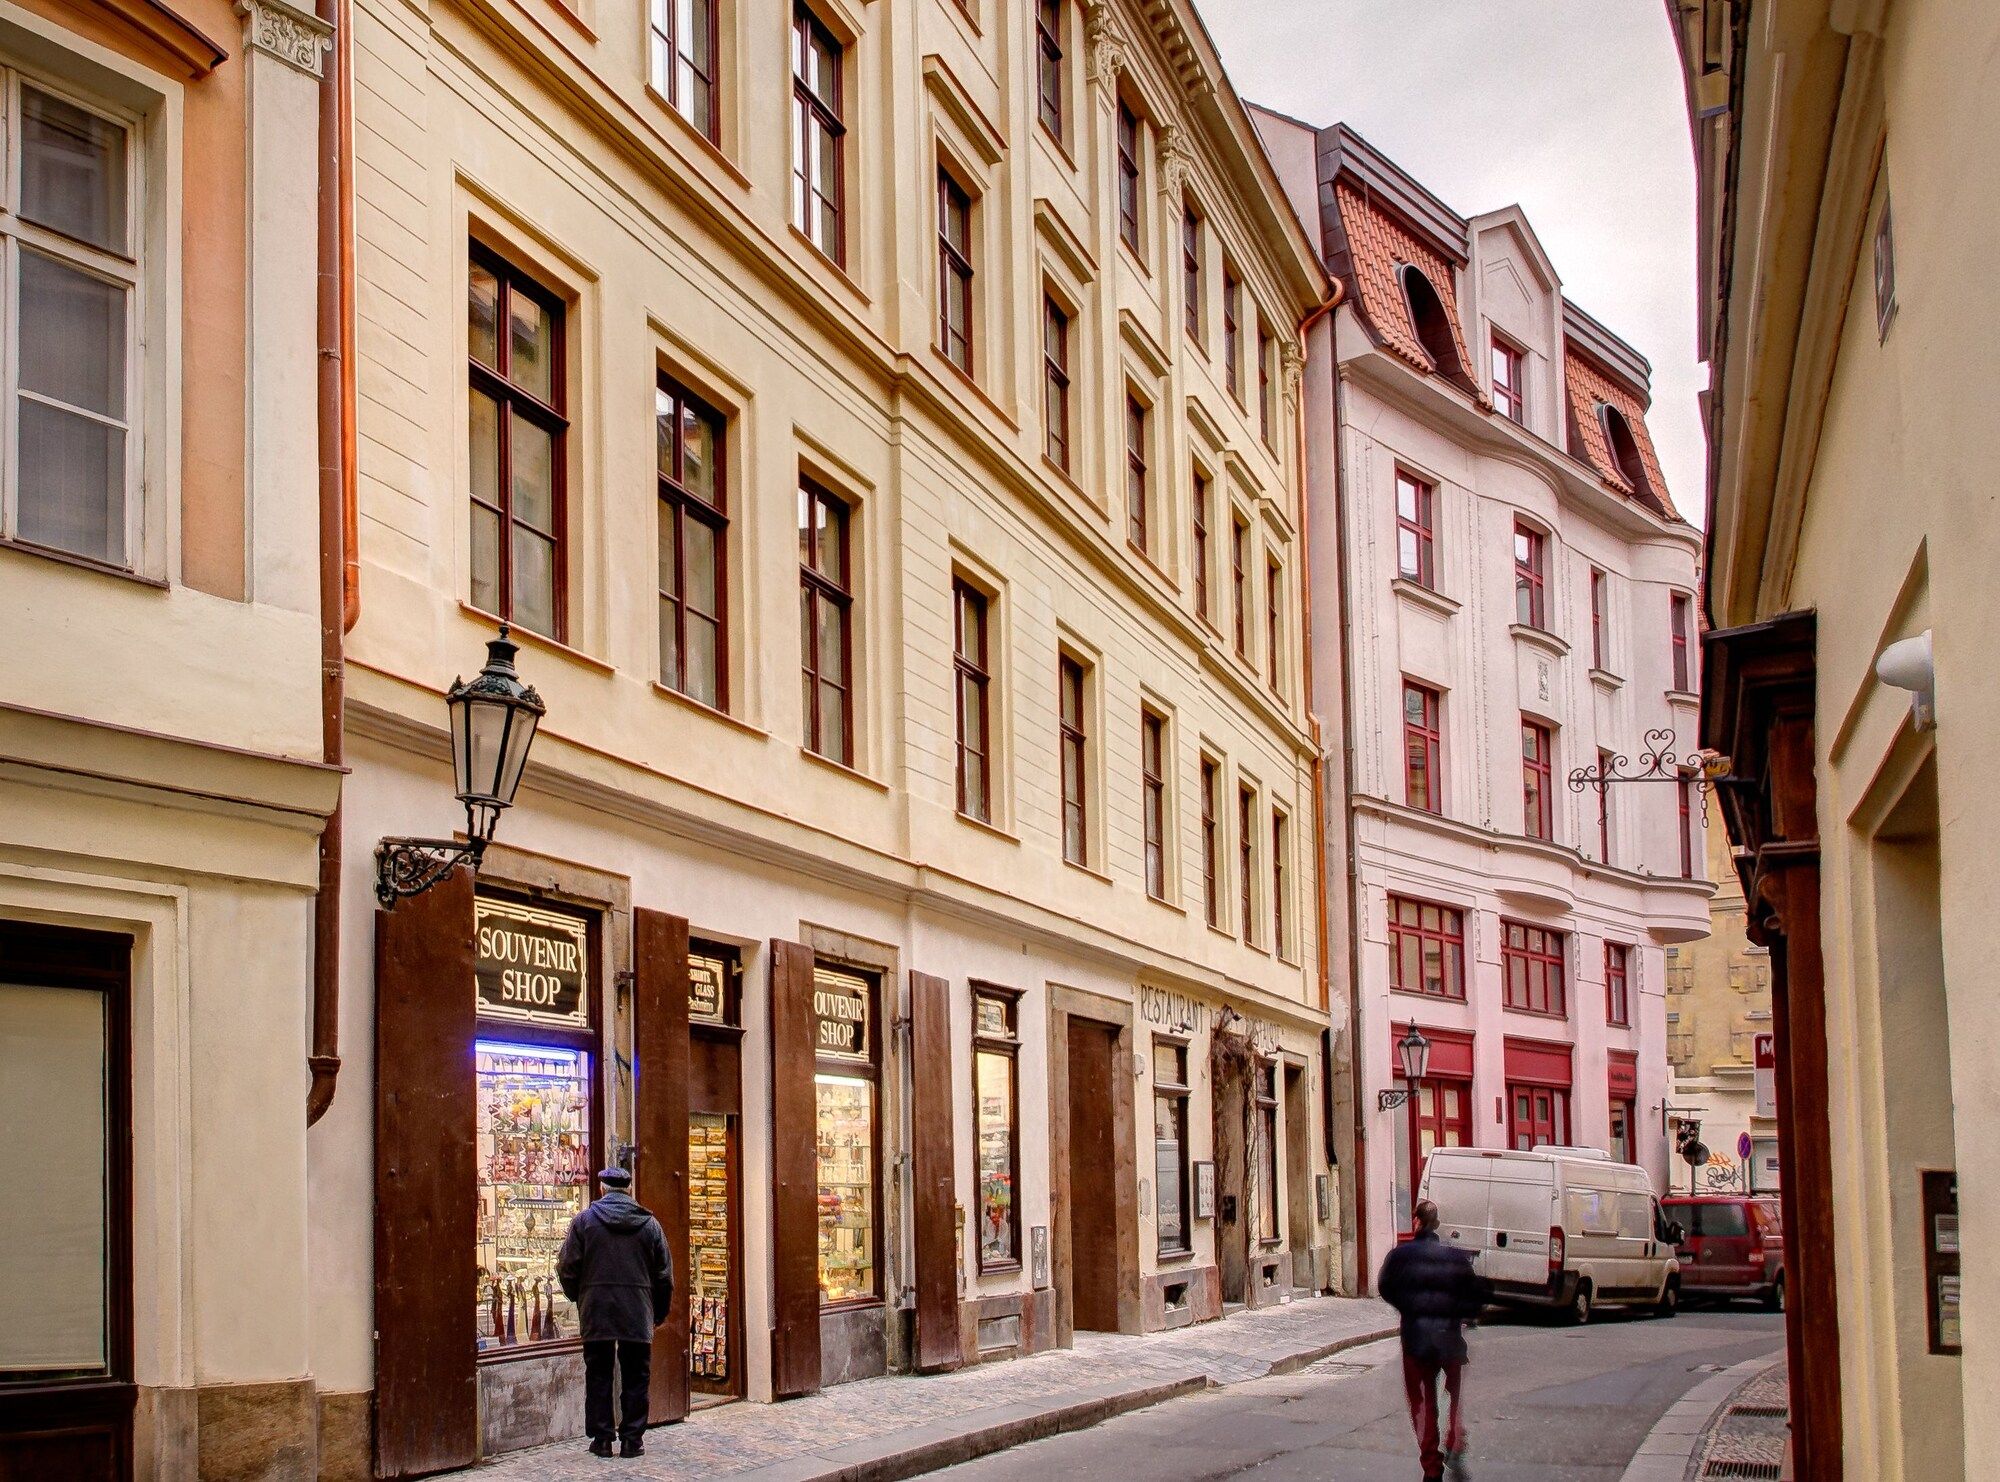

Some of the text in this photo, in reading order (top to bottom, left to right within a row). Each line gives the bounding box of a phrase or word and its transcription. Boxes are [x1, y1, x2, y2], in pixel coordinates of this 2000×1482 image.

[480, 926, 577, 973] SOUVENIR
[502, 969, 562, 1006] SHOP
[695, 982, 715, 998] GLASS
[813, 990, 864, 1022] OUVENIR
[1140, 984, 1205, 1034] RESTAURANT
[820, 1020, 855, 1047] SHOP
